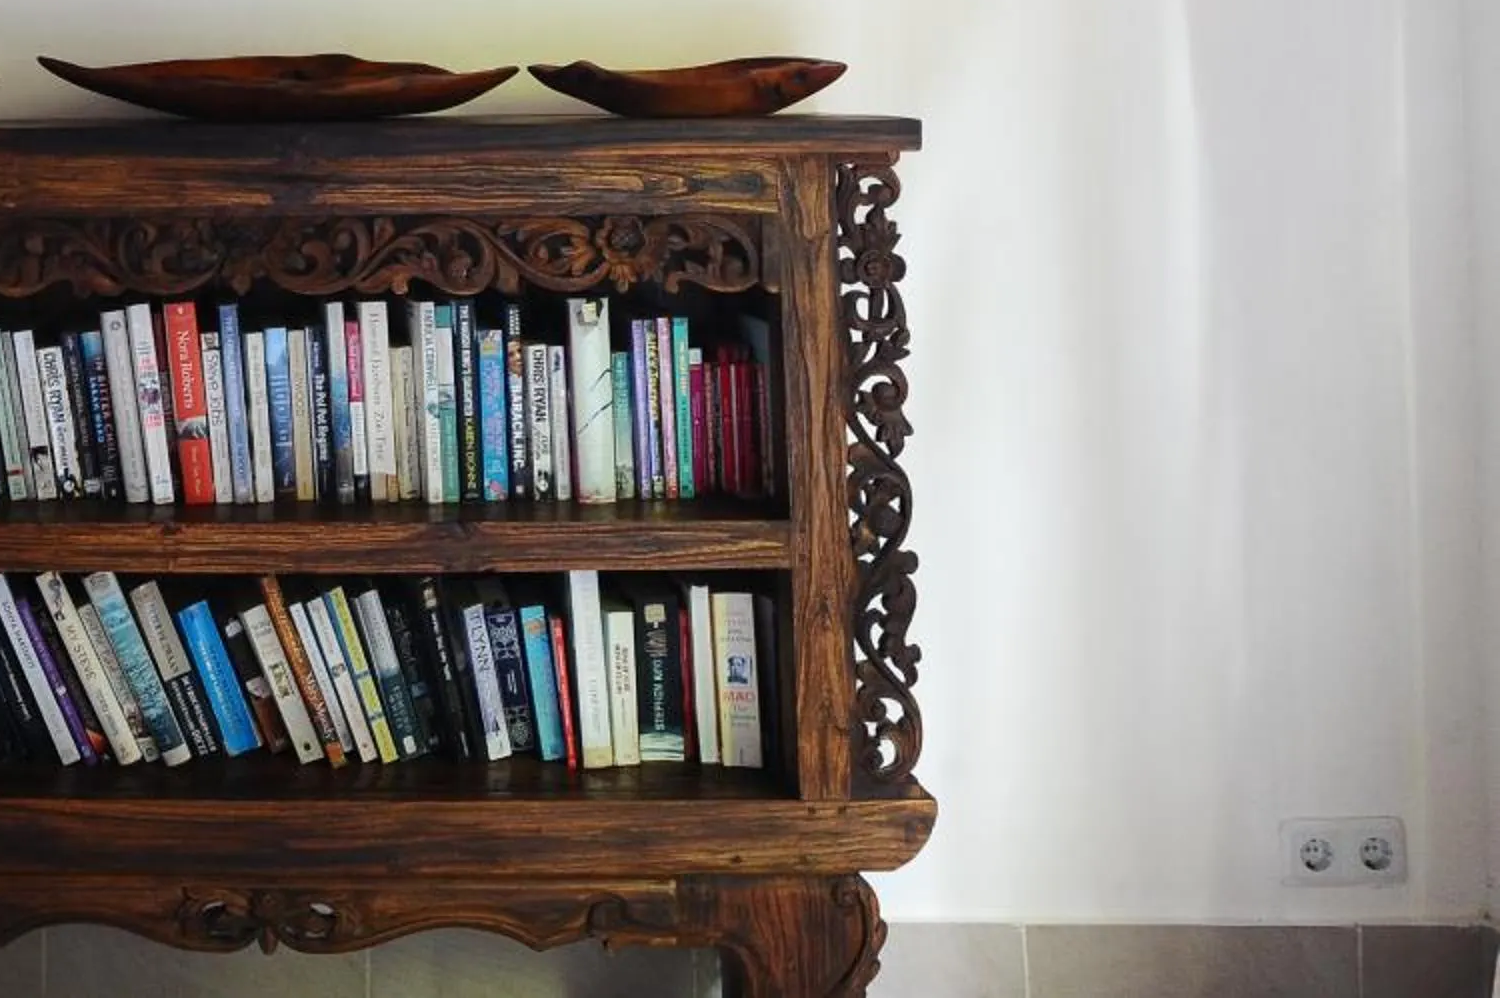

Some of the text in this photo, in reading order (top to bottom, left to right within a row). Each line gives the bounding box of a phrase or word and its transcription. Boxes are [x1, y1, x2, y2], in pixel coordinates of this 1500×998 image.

[176, 330, 196, 410] Nora Roberts
[314, 374, 325, 391] The
[532, 349, 546, 384] CHRIS
[43, 353, 66, 423] CHRIS RYAN
[206, 353, 224, 427] Steve Jobs
[316, 391, 327, 408] Pol
[534, 387, 548, 423] RYAN
[73, 645, 98, 683] STEVE
